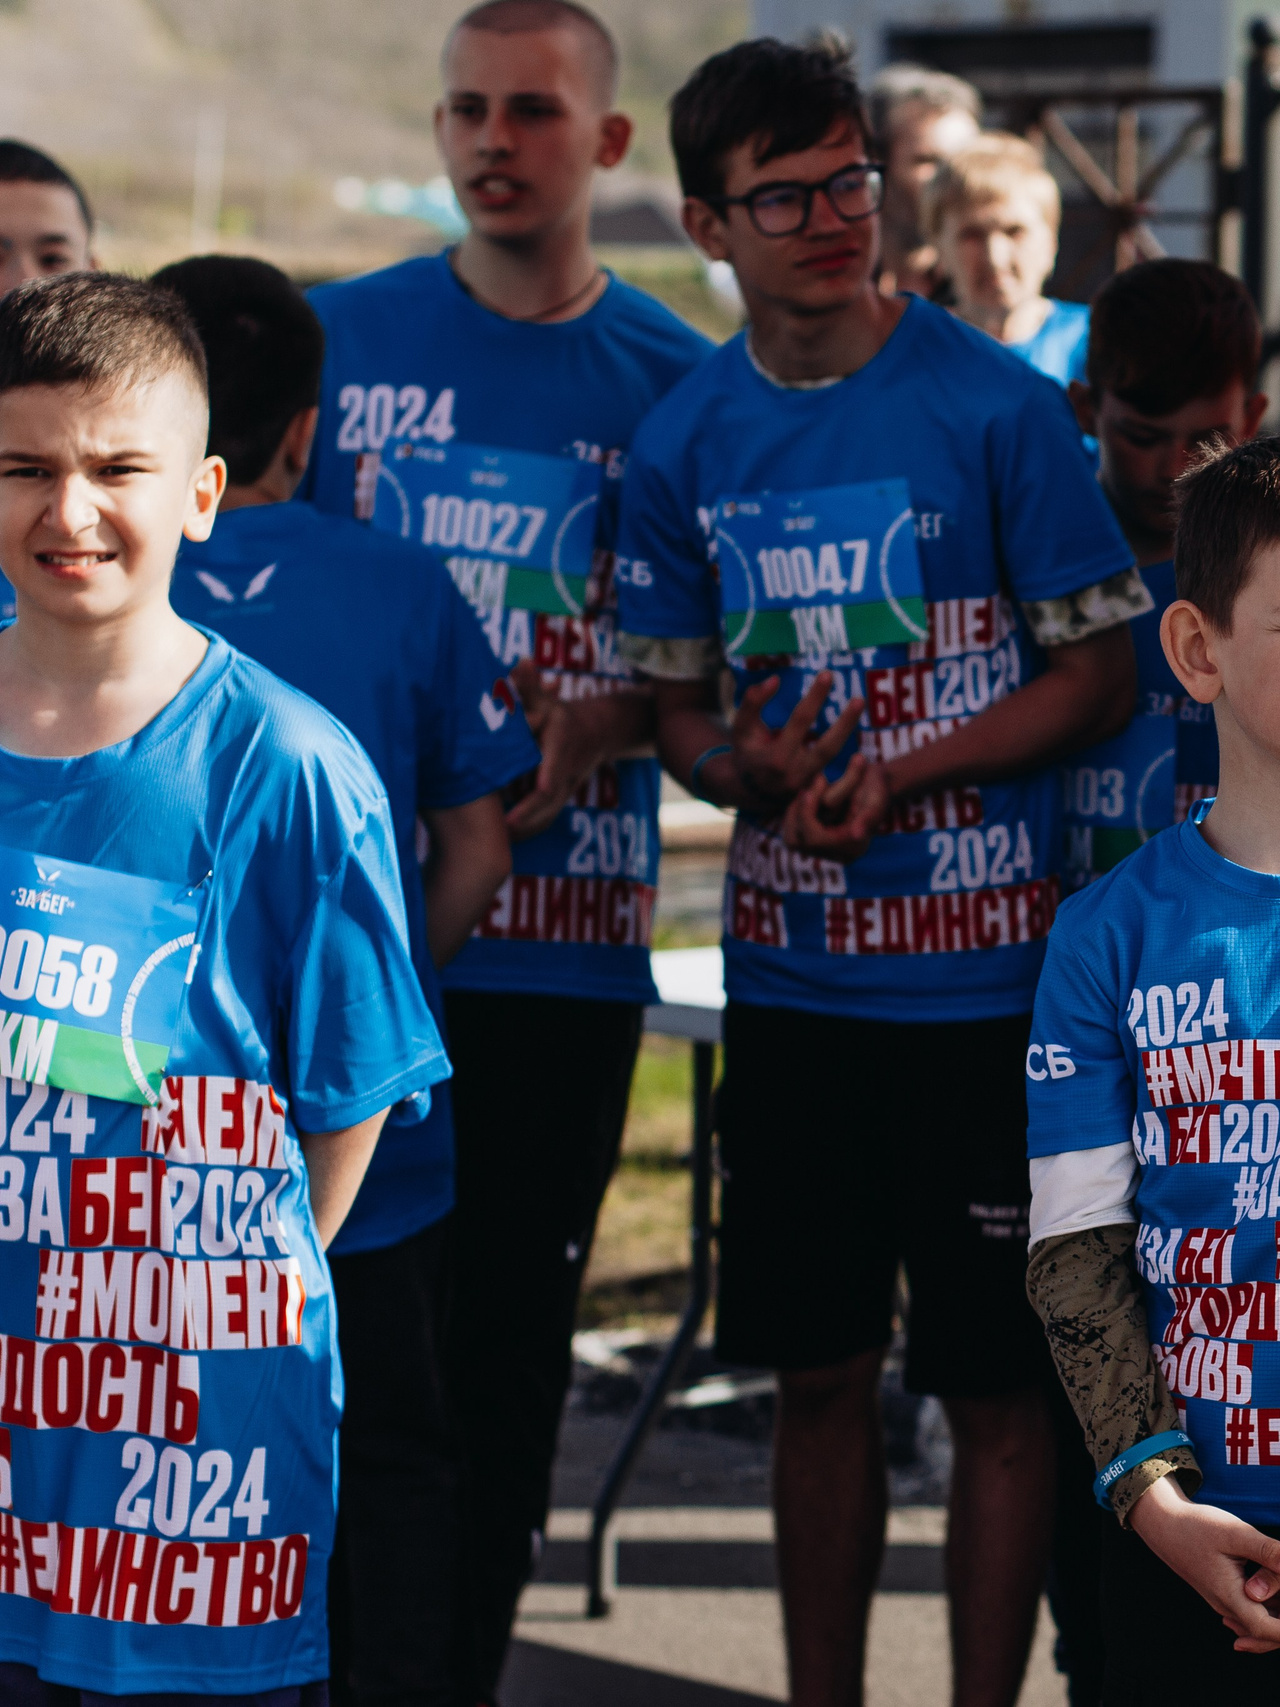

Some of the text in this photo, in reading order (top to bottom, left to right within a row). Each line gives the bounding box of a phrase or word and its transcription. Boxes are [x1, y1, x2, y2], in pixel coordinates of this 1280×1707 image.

[337, 384, 456, 450] 2024
[421, 494, 547, 558] 10027
[757, 538, 869, 599] 10047
[929, 822, 1034, 893] 2024
[0, 925, 118, 1018] 058
[1128, 978, 1229, 1048] 2024
[1026, 1043, 1077, 1082] СБ
[36, 1248, 305, 1350] #МОМЕНТ
[115, 1436, 270, 1538] 2024
[0, 1510, 310, 1628] #ЕДИНСТВО
